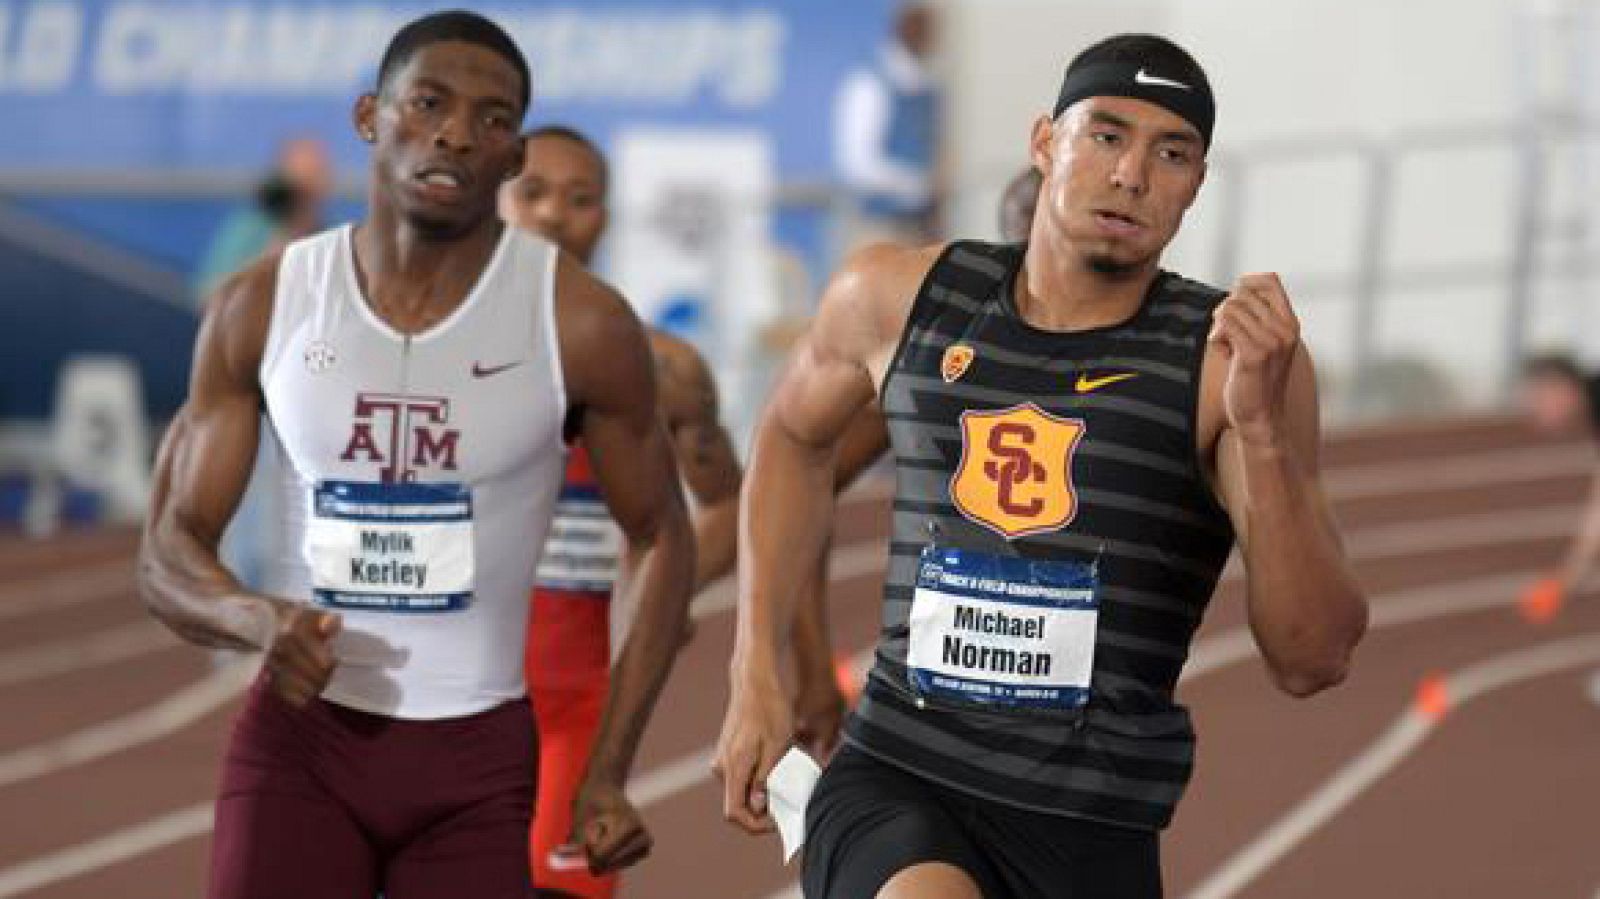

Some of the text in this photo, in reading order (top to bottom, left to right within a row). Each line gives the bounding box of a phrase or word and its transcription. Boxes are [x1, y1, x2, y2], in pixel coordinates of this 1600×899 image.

[983, 422, 1047, 517] SC
[361, 530, 414, 555] Mylik
[350, 558, 427, 588] Kerley
[954, 604, 1046, 639] Michael
[942, 634, 1052, 676] Norman
